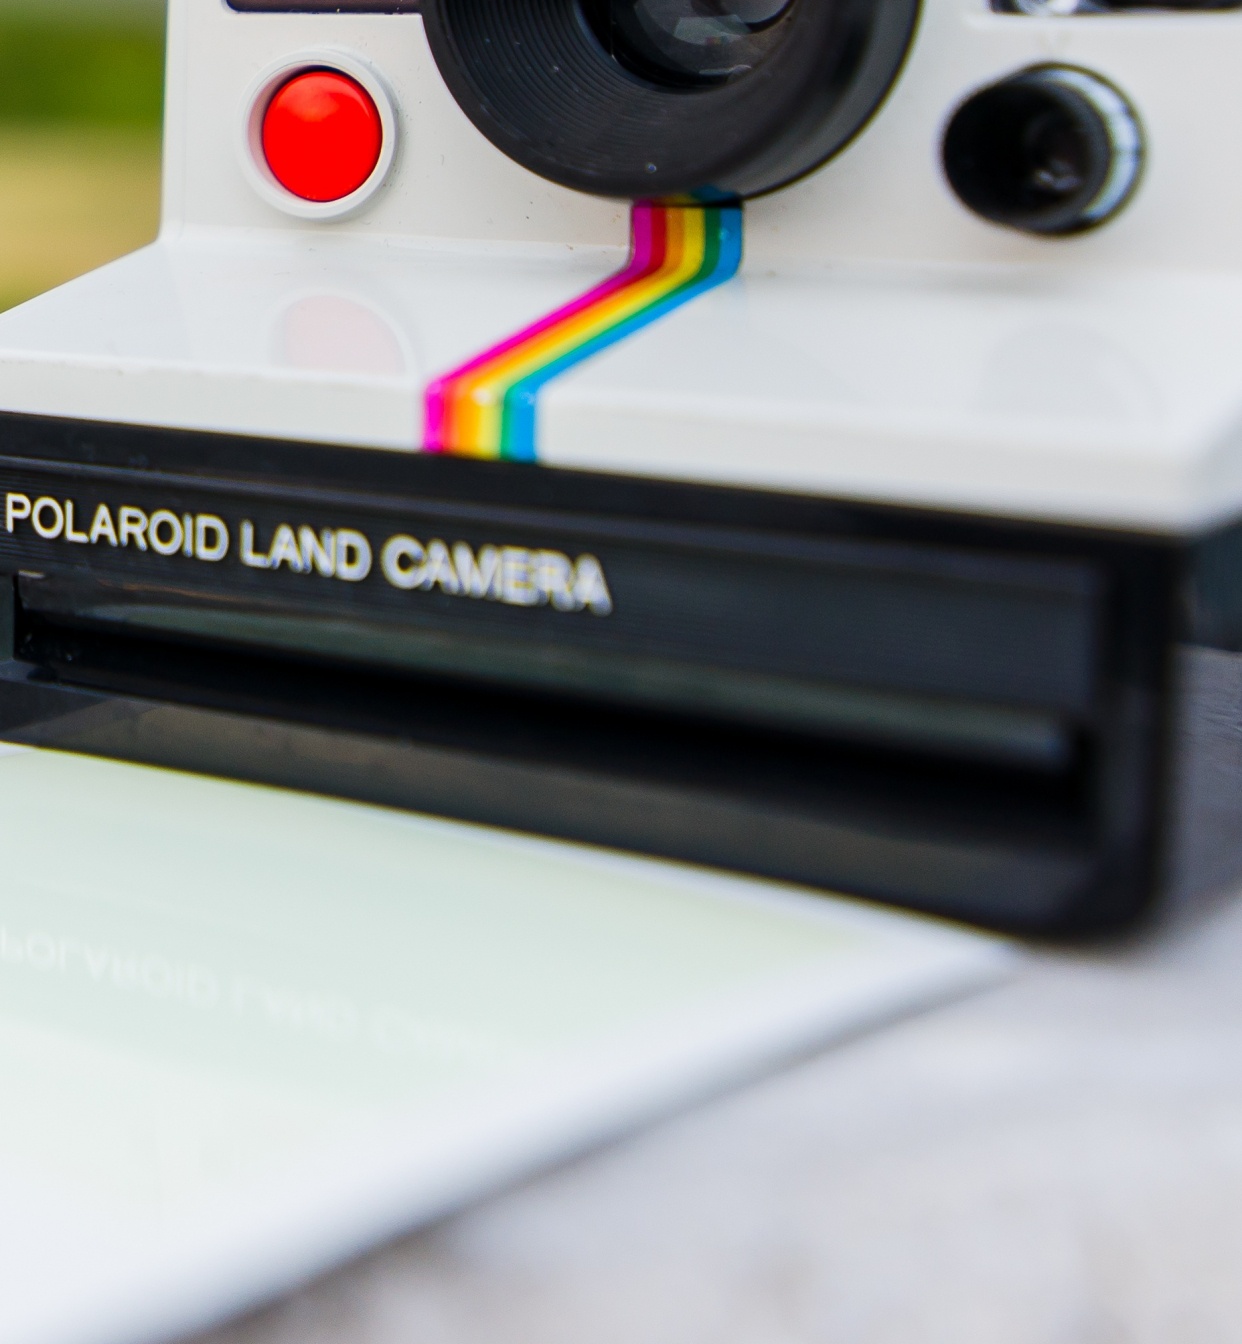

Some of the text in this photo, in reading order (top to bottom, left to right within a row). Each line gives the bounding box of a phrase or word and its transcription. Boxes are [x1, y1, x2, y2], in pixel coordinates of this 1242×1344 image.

[5, 492, 614, 617] POLAROID LAND CAMERA
